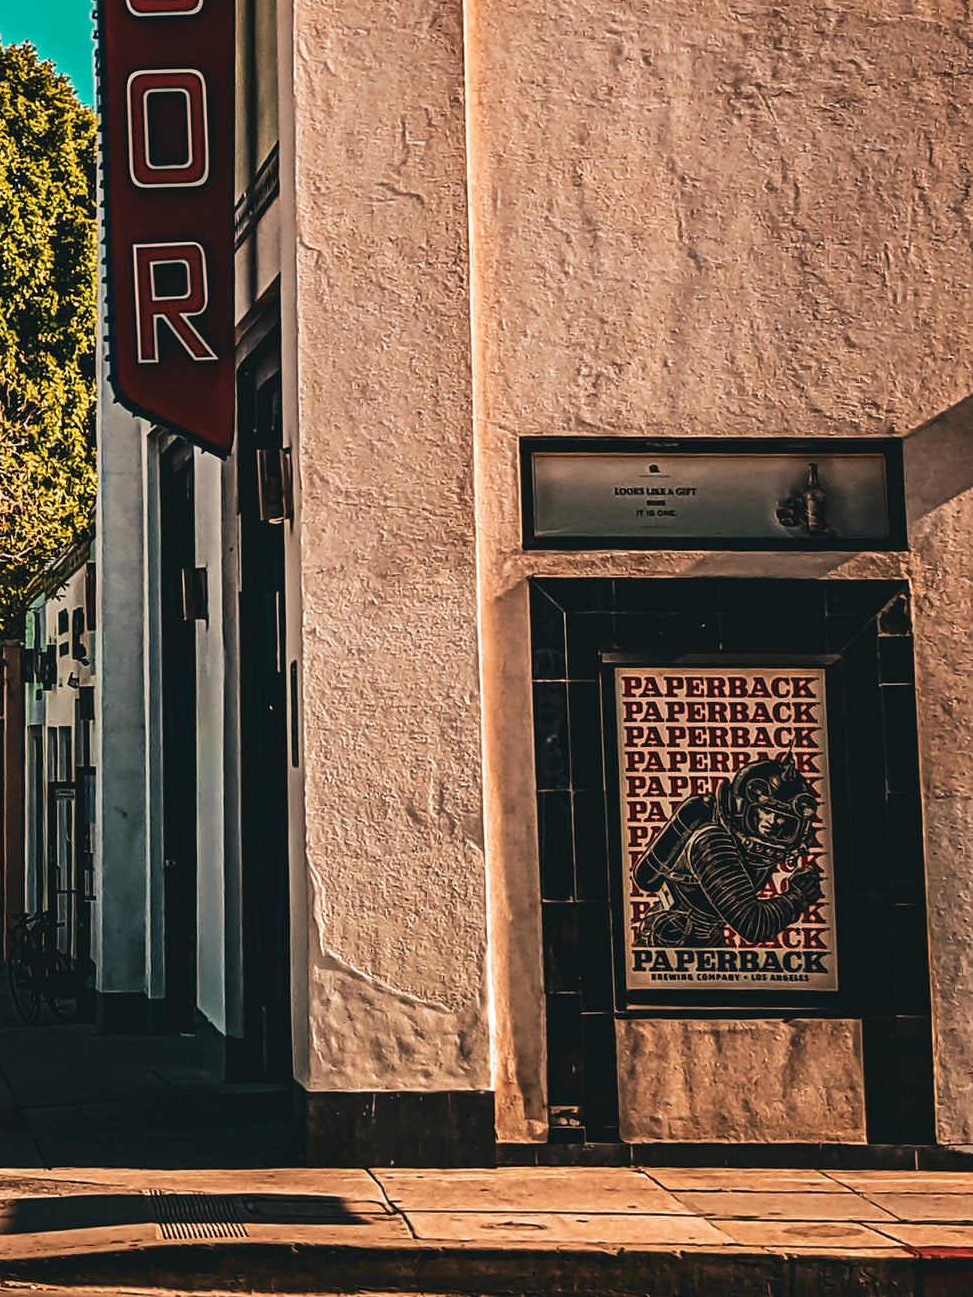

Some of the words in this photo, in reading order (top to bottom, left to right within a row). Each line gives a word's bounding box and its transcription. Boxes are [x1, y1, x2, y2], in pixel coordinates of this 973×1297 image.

[614, 487, 645, 496] LOOKS
[646, 487, 666, 496] LIKE
[667, 487, 674, 496] A
[675, 487, 697, 496] GIFT
[621, 676, 819, 698] PAPERBACK
[623, 701, 821, 723] PAPERBACK
[624, 726, 822, 748] PAPERBACK
[631, 950, 830, 973] PAPERBACK
[651, 973, 694, 981] BREWING
[697, 973, 740, 982] COMPANY
[751, 973, 767, 982] LOS
